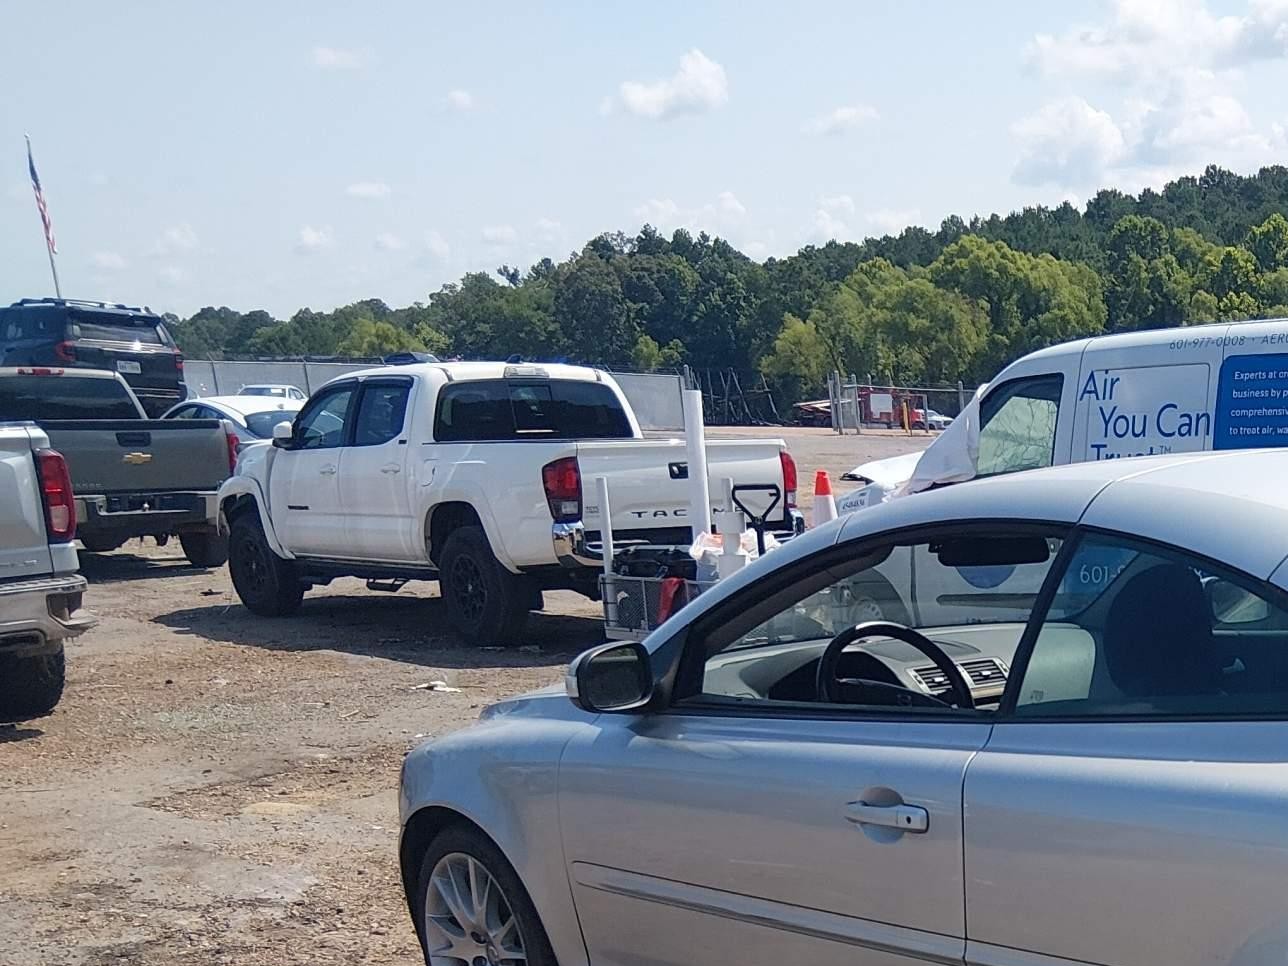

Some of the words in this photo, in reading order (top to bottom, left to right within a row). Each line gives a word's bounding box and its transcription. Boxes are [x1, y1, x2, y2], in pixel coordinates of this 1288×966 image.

[1169, 335, 1246, 350] 601-977-0008
[1234, 370, 1267, 381] Experts
[1267, 370, 1277, 379] at
[1080, 369, 1120, 401] Air
[1232, 388, 1269, 399] business
[1270, 388, 1281, 399] by
[1099, 405, 1147, 438] You
[1156, 403, 1211, 438] Can
[1229, 427, 1239, 436] to
[1239, 426, 1260, 435] treat
[1261, 425, 1275, 436] air,
